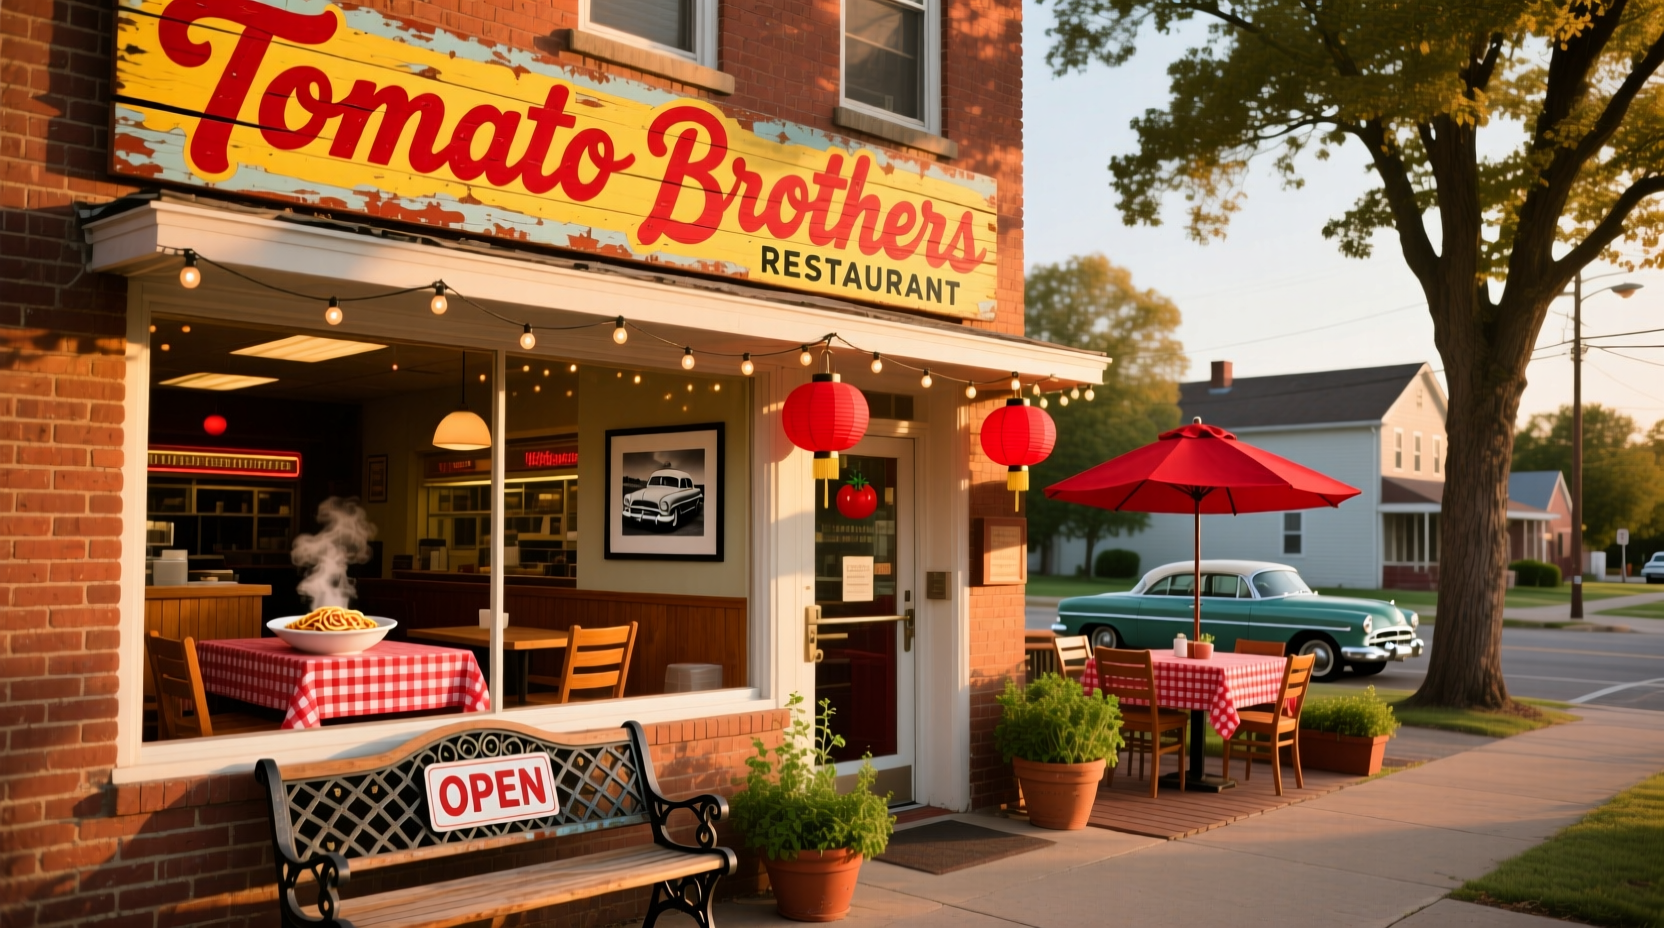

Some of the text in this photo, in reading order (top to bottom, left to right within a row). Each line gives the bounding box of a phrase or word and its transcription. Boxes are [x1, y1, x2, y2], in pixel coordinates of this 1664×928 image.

[158, 0, 985, 274] Tomato Brothers
[761, 245, 960, 306] RESTAURANT
[439, 766, 547, 817] OPEN
